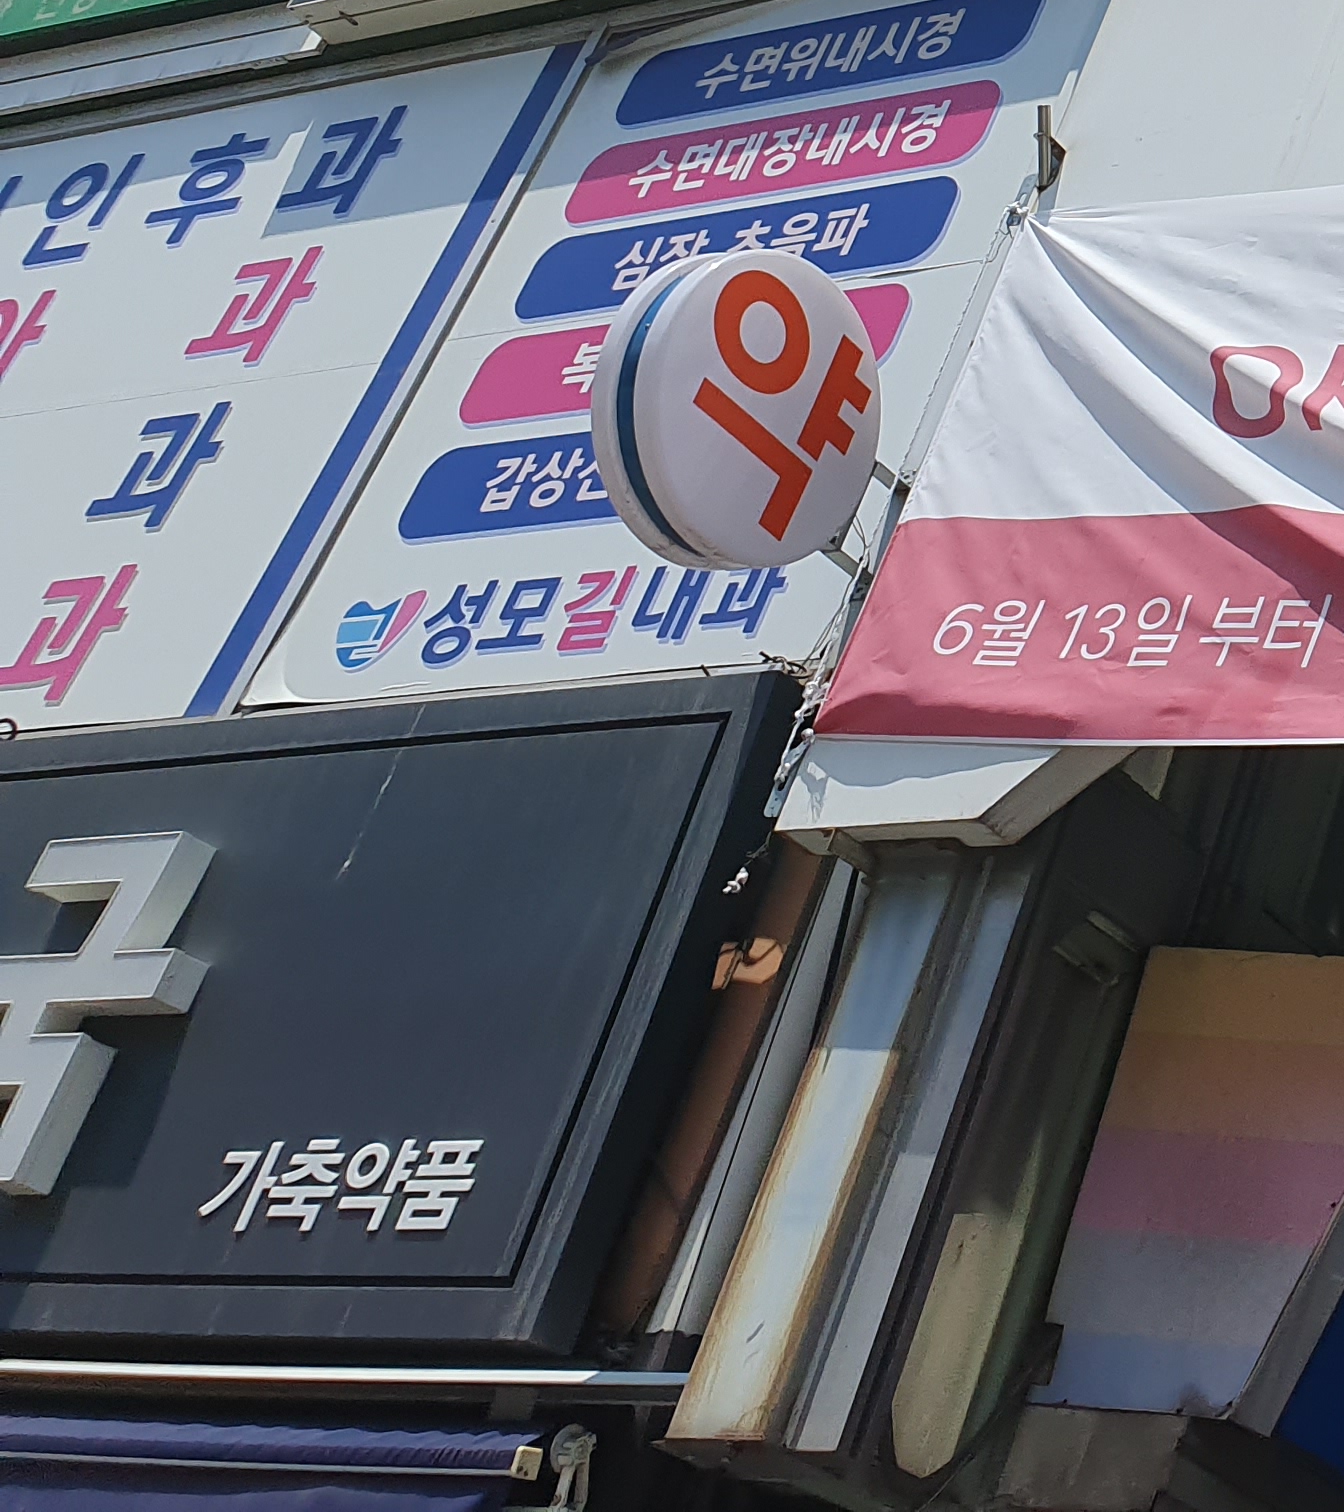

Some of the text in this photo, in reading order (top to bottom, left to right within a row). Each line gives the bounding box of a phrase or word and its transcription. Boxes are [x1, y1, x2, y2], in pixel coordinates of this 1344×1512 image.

[696, 8, 967, 100] 수면위내시경
[627, 100, 952, 200] 수면대장내시경
[693, 269, 873, 541] 약
[86, 401, 232, 532] 과
[421, 565, 788, 668] 성모길내과
[931, 599, 1047, 669] 6월
[199, 1138, 484, 1233] 가축약품
